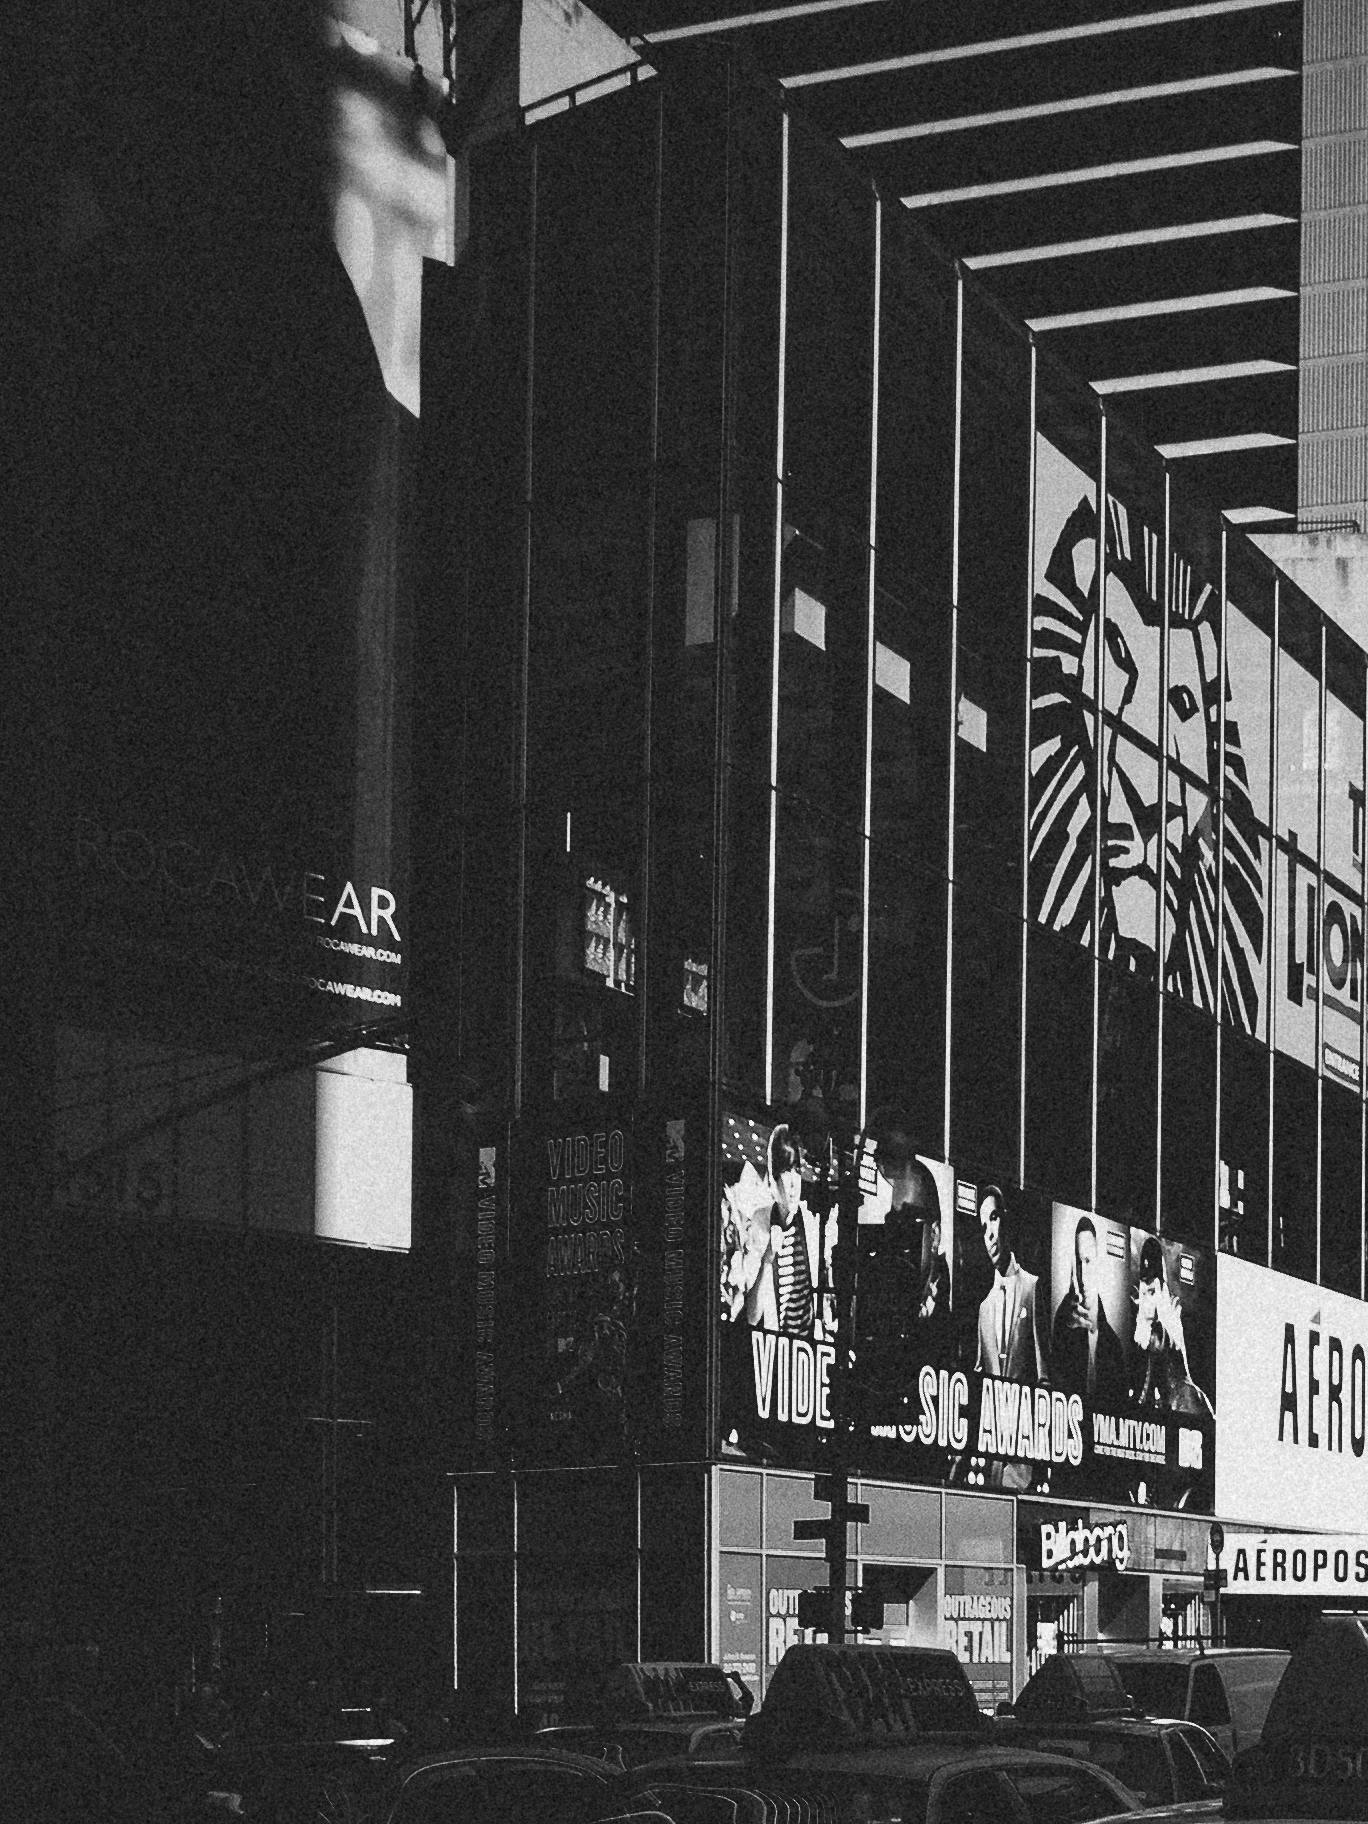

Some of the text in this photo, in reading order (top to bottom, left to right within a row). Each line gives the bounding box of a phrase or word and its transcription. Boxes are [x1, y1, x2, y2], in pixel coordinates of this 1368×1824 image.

[546, 1129, 625, 1181] VIDEO
[546, 1178, 625, 1229] MUSIC
[977, 1377, 1084, 1466] AWARDS
[1040, 1519, 1130, 1571] Billabong
[944, 1594, 1012, 1619] OUTRAGEOUS
[944, 1620, 1012, 1664] RETAIL
